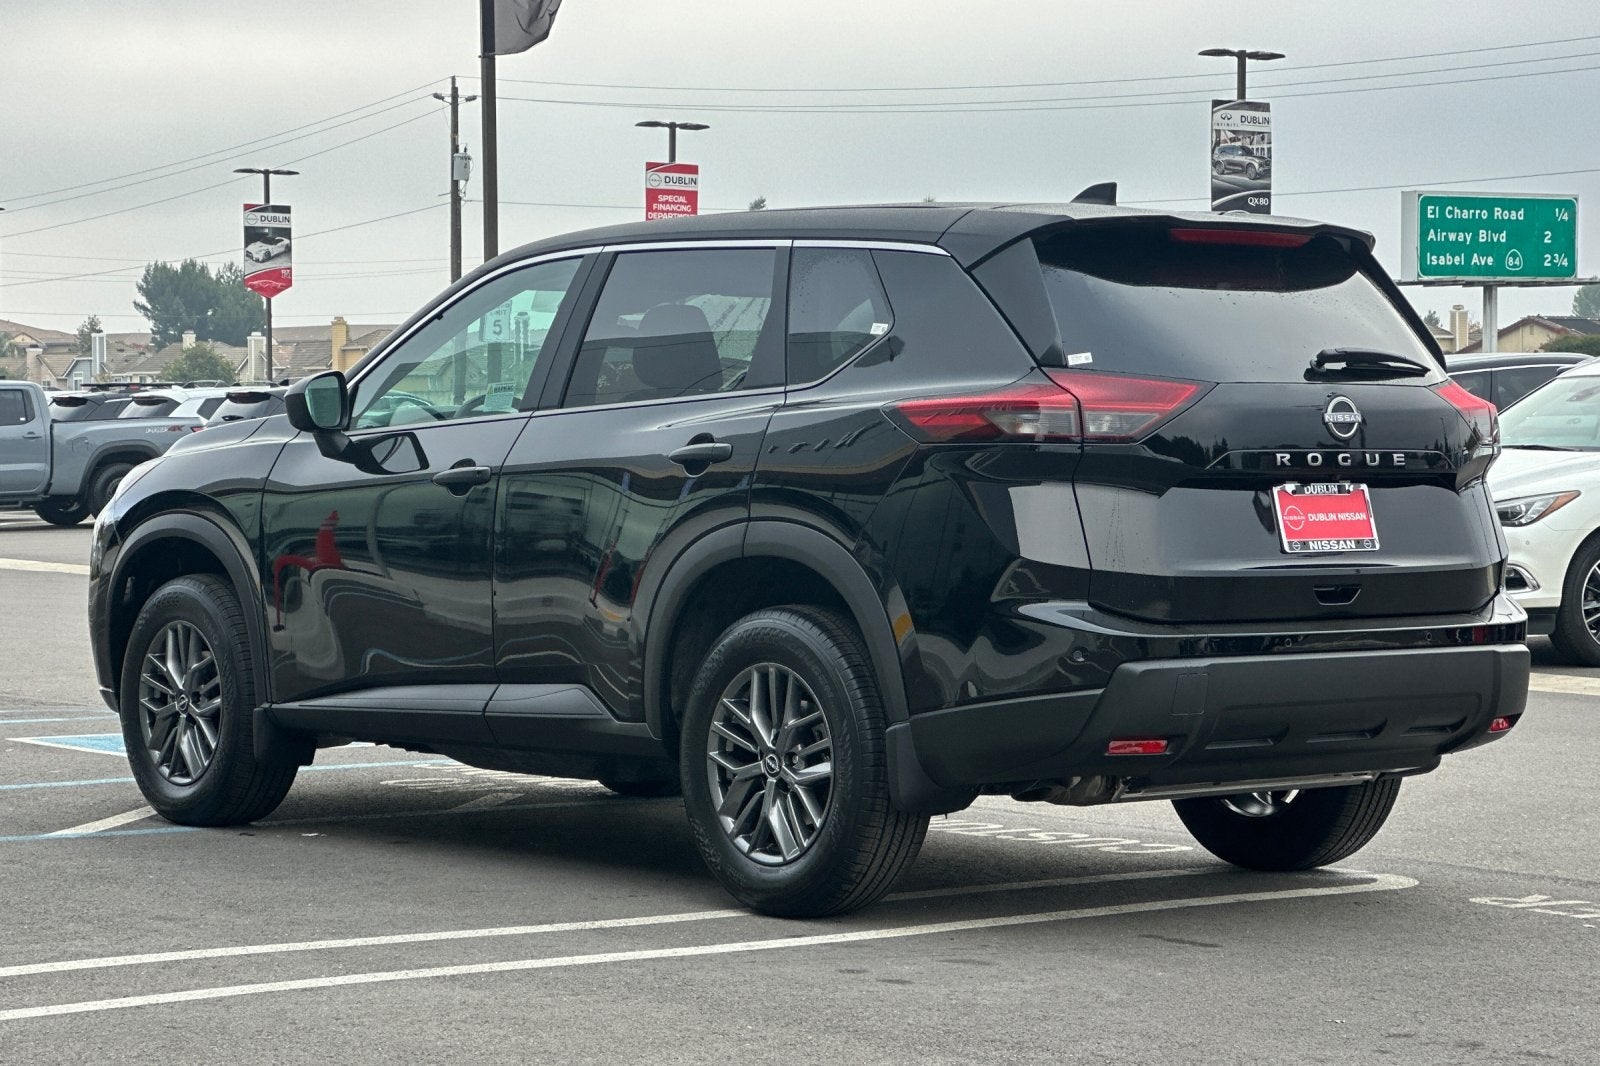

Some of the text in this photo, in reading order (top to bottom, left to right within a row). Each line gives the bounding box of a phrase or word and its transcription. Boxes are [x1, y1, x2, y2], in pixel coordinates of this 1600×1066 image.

[1240, 115, 1270, 125] DUBLIN
[664, 175, 697, 186] DUBLIN
[658, 194, 687, 203] SPECIAL
[1247, 196, 1269, 206] QX80
[653, 203, 692, 212] FINANCING
[1427, 206, 1439, 219] El
[1445, 206, 1488, 220] Charro
[1494, 207, 1525, 220] Road
[260, 214, 290, 224] DUBLIN
[1427, 229, 1552, 245] Airway Blvd 2
[1427, 252, 1465, 266] Isabel
[1471, 253, 1494, 266] Ave
[1507, 256, 1520, 266] 84
[493, 319, 502, 336] 5
[1325, 412, 1362, 423] NISSAN
[1275, 452, 1406, 467] ROGUE
[1304, 484, 1339, 495] DUBLIN
[1307, 513, 1337, 522] DUBLIN
[1337, 512, 1367, 521] NISSAN
[1308, 540, 1357, 551] NISSAN
